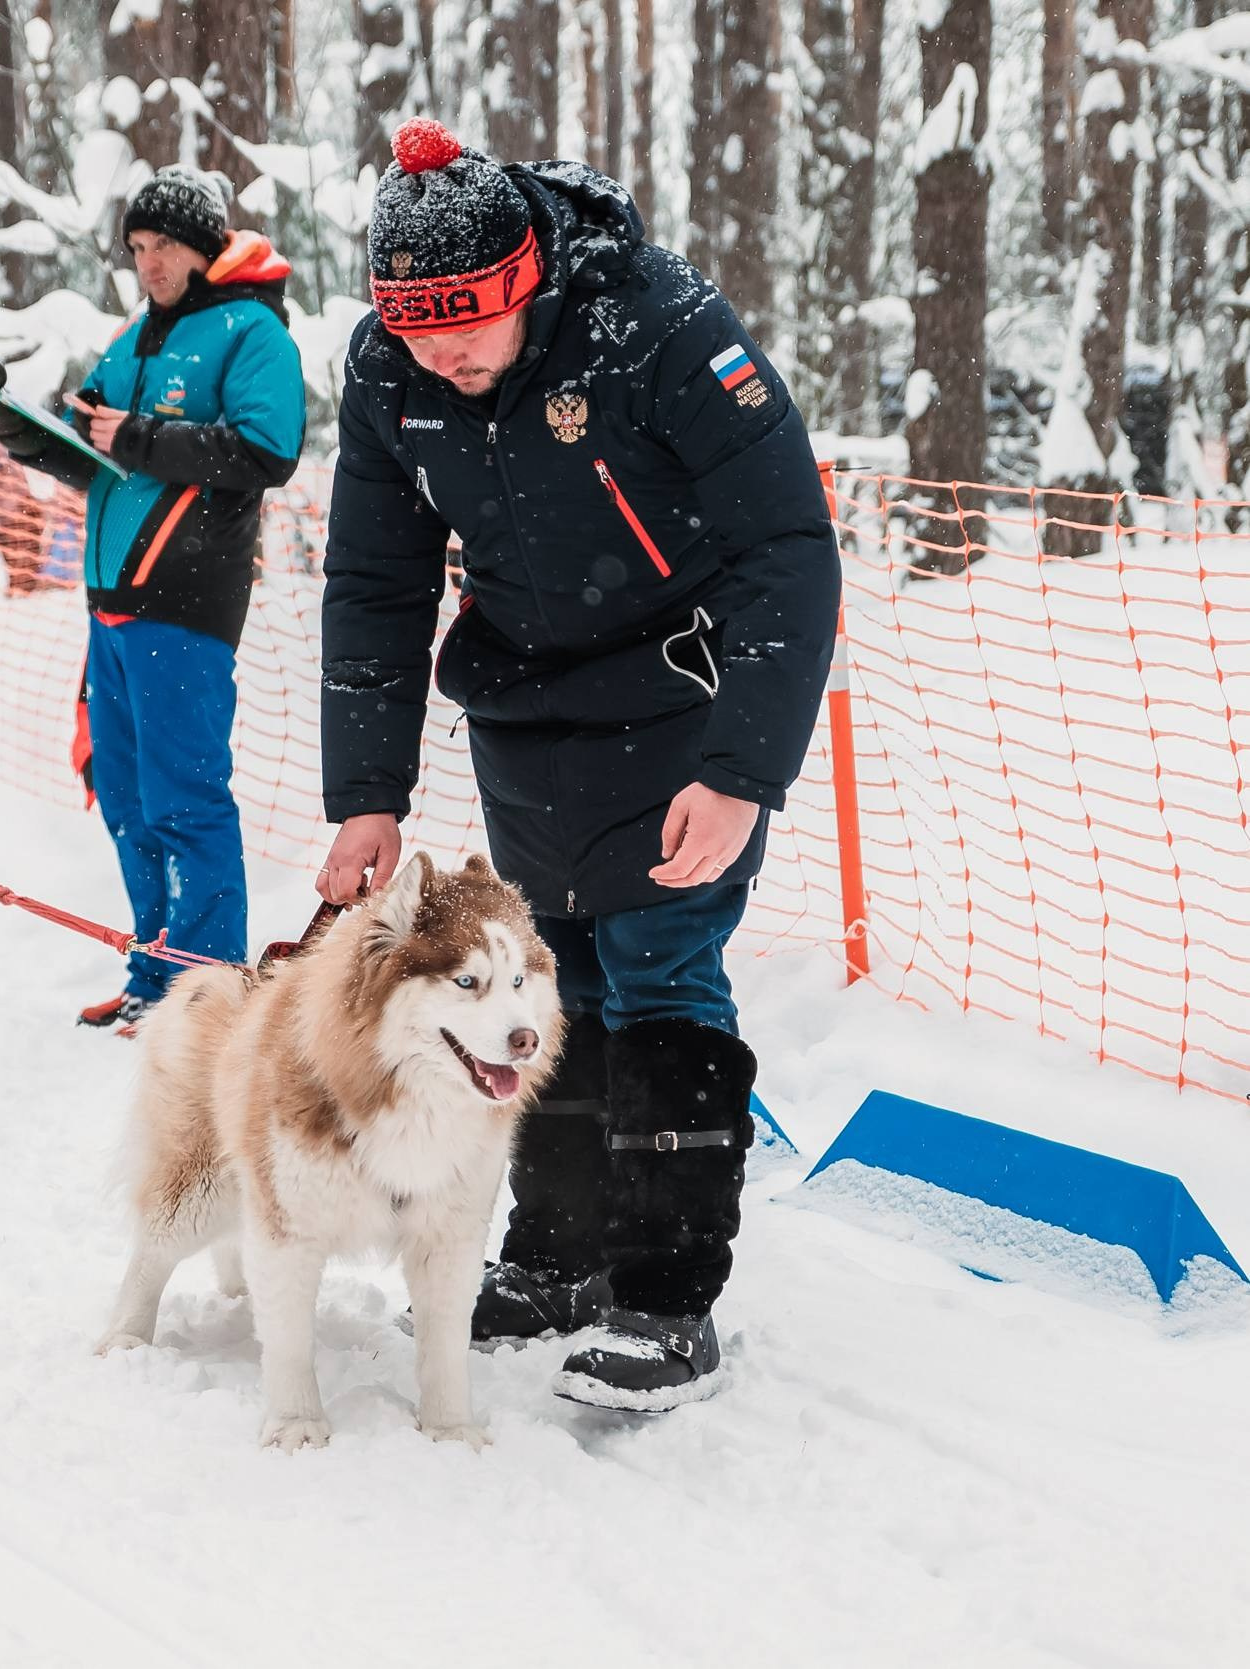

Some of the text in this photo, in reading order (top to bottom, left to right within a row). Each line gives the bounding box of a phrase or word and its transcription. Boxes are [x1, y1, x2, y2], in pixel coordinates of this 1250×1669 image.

[735, 378, 762, 398] RUSSIAN
[737, 384, 768, 407] NATIONAL
[749, 393, 768, 408] TEAM
[401, 416, 444, 430] FORWARD
